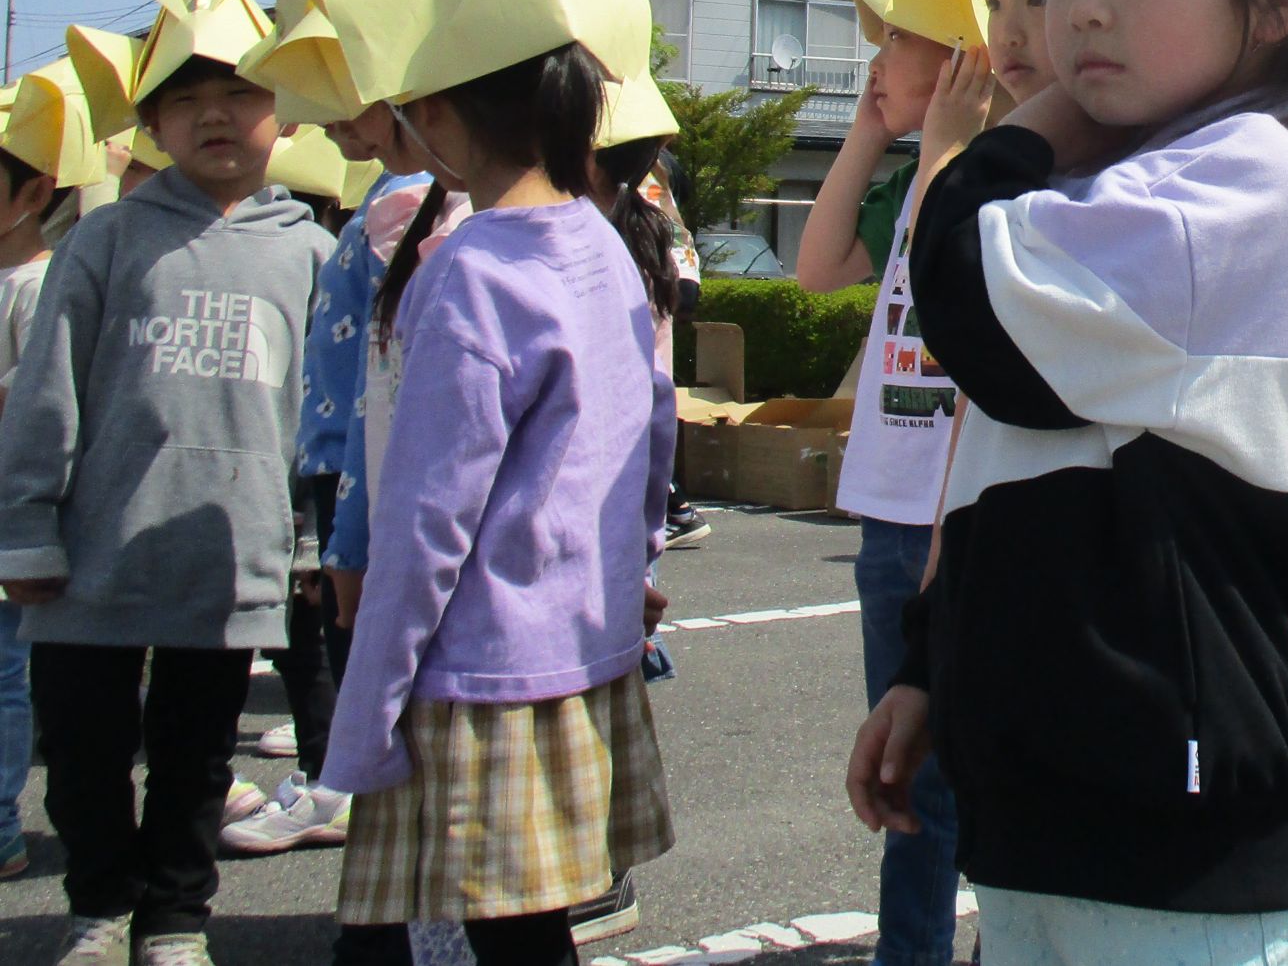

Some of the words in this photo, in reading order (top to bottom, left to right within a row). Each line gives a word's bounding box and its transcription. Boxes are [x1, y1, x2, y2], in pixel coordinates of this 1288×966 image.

[181, 289, 250, 322] THE
[128, 316, 247, 350] NORTH
[152, 345, 243, 379] FACE
